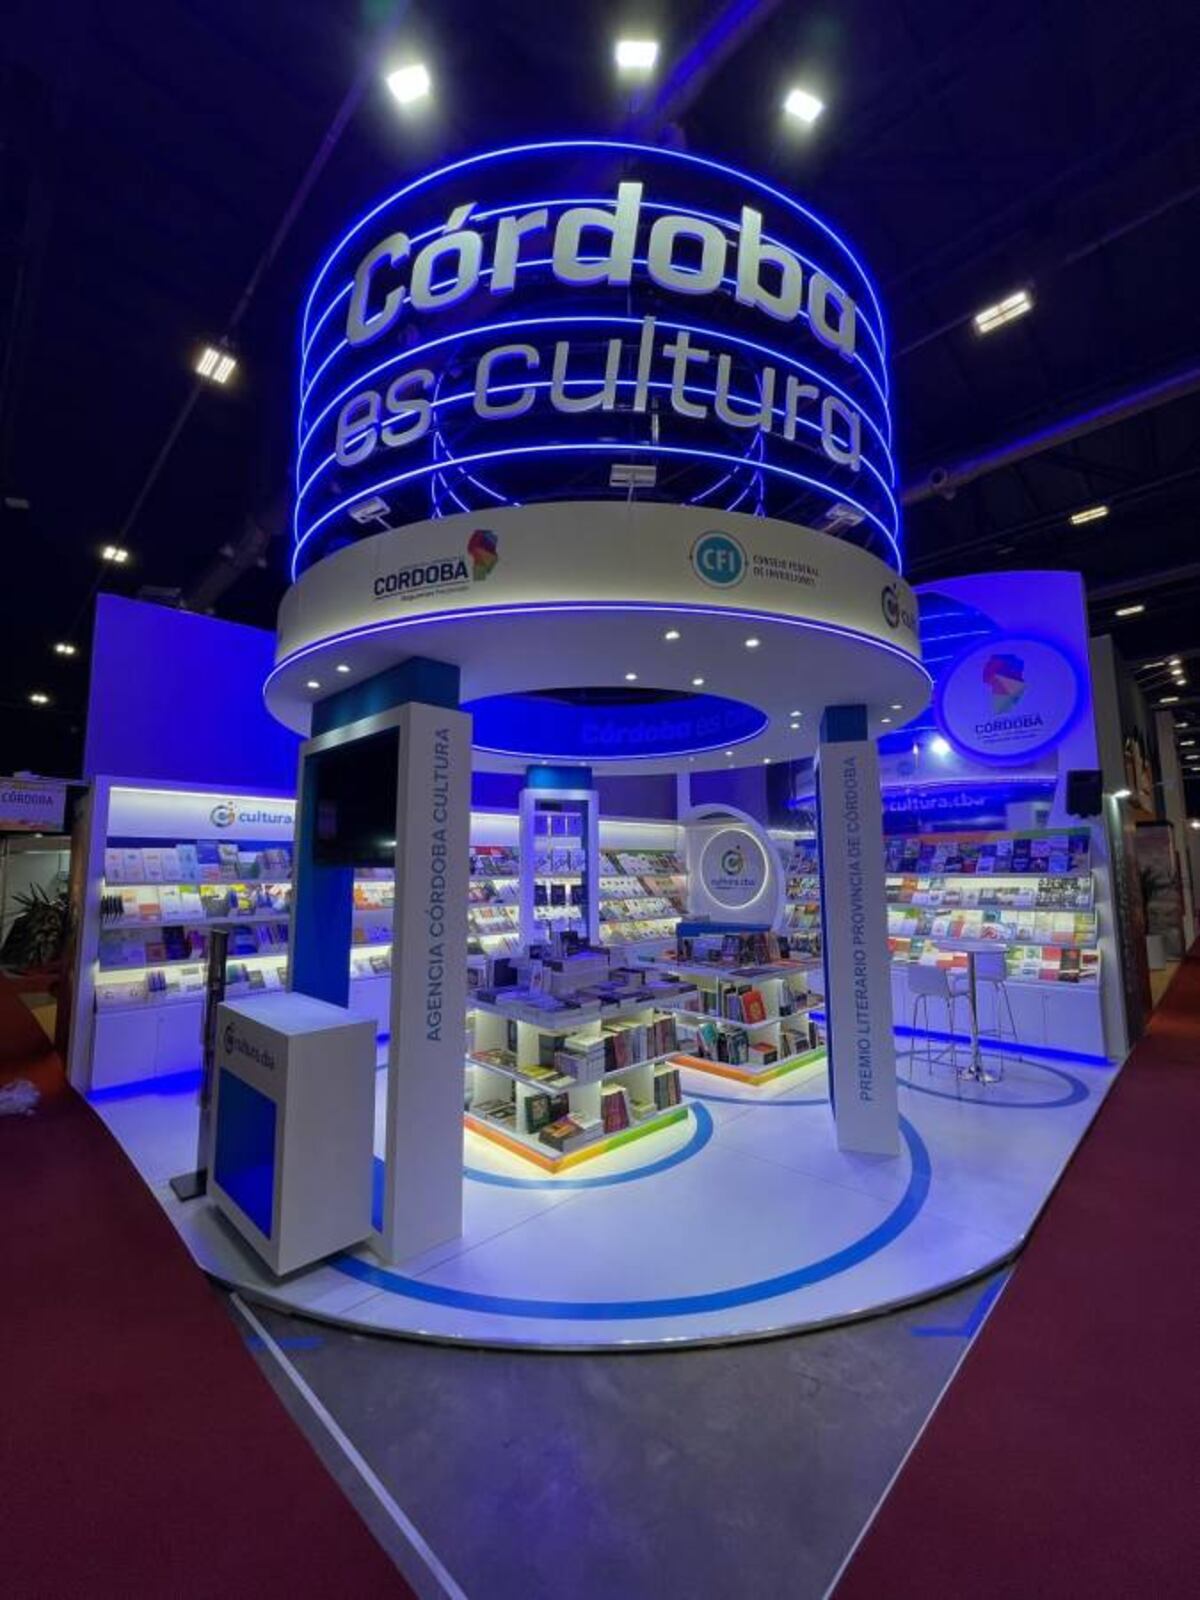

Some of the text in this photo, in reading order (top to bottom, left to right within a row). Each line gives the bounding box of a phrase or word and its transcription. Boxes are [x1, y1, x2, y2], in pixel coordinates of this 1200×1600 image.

[346, 182, 856, 358] Córdoba
[334, 315, 861, 471] es cultura
[703, 547, 736, 573] CFI
[424, 728, 450, 1041] AGENCIA CÓRDOBA CULTURA
[843, 756, 873, 1102] PREMIO LITERARIO PROVINCIA DE CÓRDOBA
